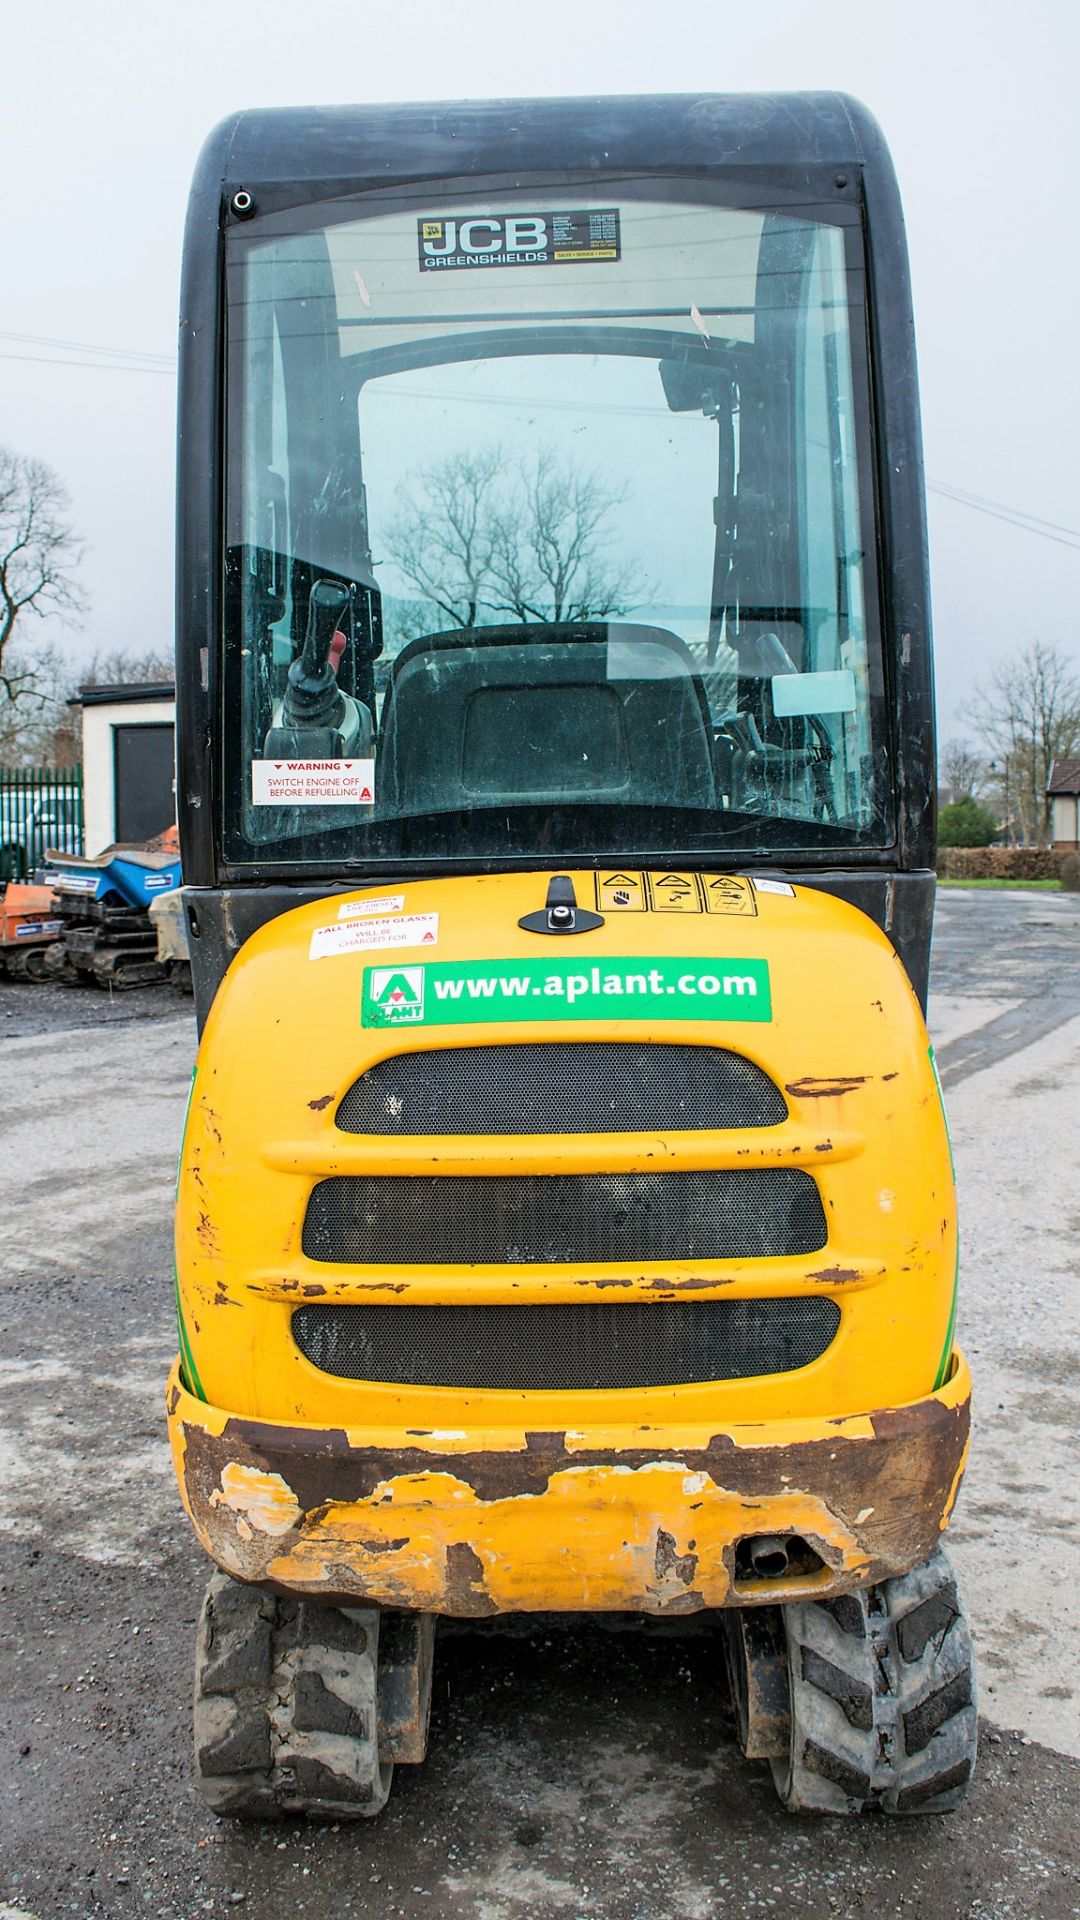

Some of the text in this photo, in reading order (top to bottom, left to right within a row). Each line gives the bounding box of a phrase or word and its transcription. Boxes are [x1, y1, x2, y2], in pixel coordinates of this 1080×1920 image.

[423, 217, 548, 256] JCB
[424, 252, 548, 267] GREENSHIELDS
[287, 762, 341, 770] WARNING
[267, 777, 360, 787] SWITCH ENGINE OFF
[270, 788, 358, 797] BEFORE REFUELLING
[324, 915, 427, 934] ALL BROKEN GLASS
[355, 929, 378, 938] WILL
[338, 934, 408, 948] CHARGED FOR
[377, 973, 418, 1003] A
[434, 967, 758, 1004] www.aplant.com
